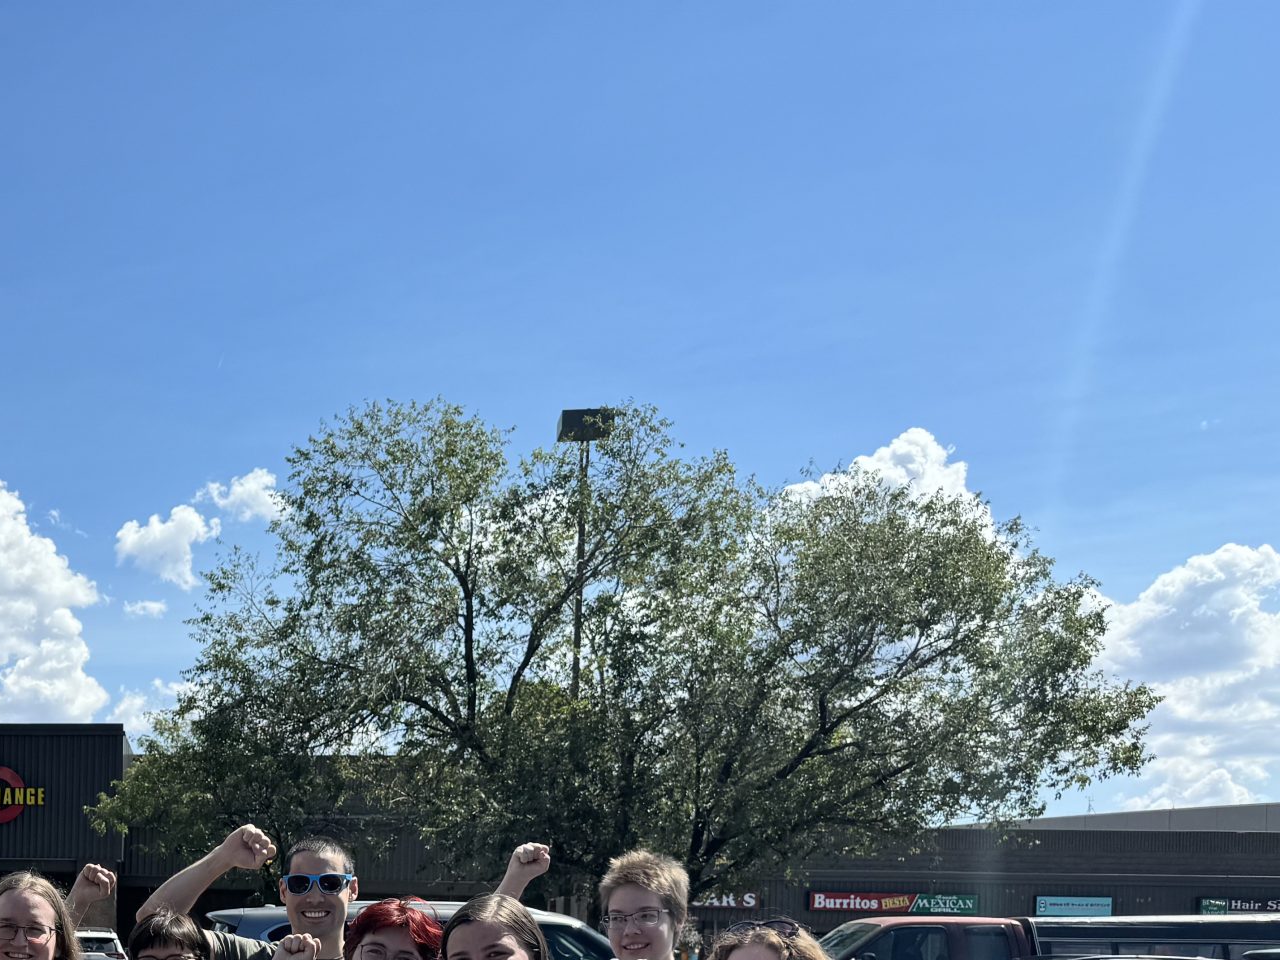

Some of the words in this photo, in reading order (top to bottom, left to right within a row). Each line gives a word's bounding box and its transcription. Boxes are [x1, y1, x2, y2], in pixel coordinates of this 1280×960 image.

[814, 894, 878, 909] Burritos
[913, 898, 973, 911] MEXICAN
[1231, 900, 1262, 910] Hair
